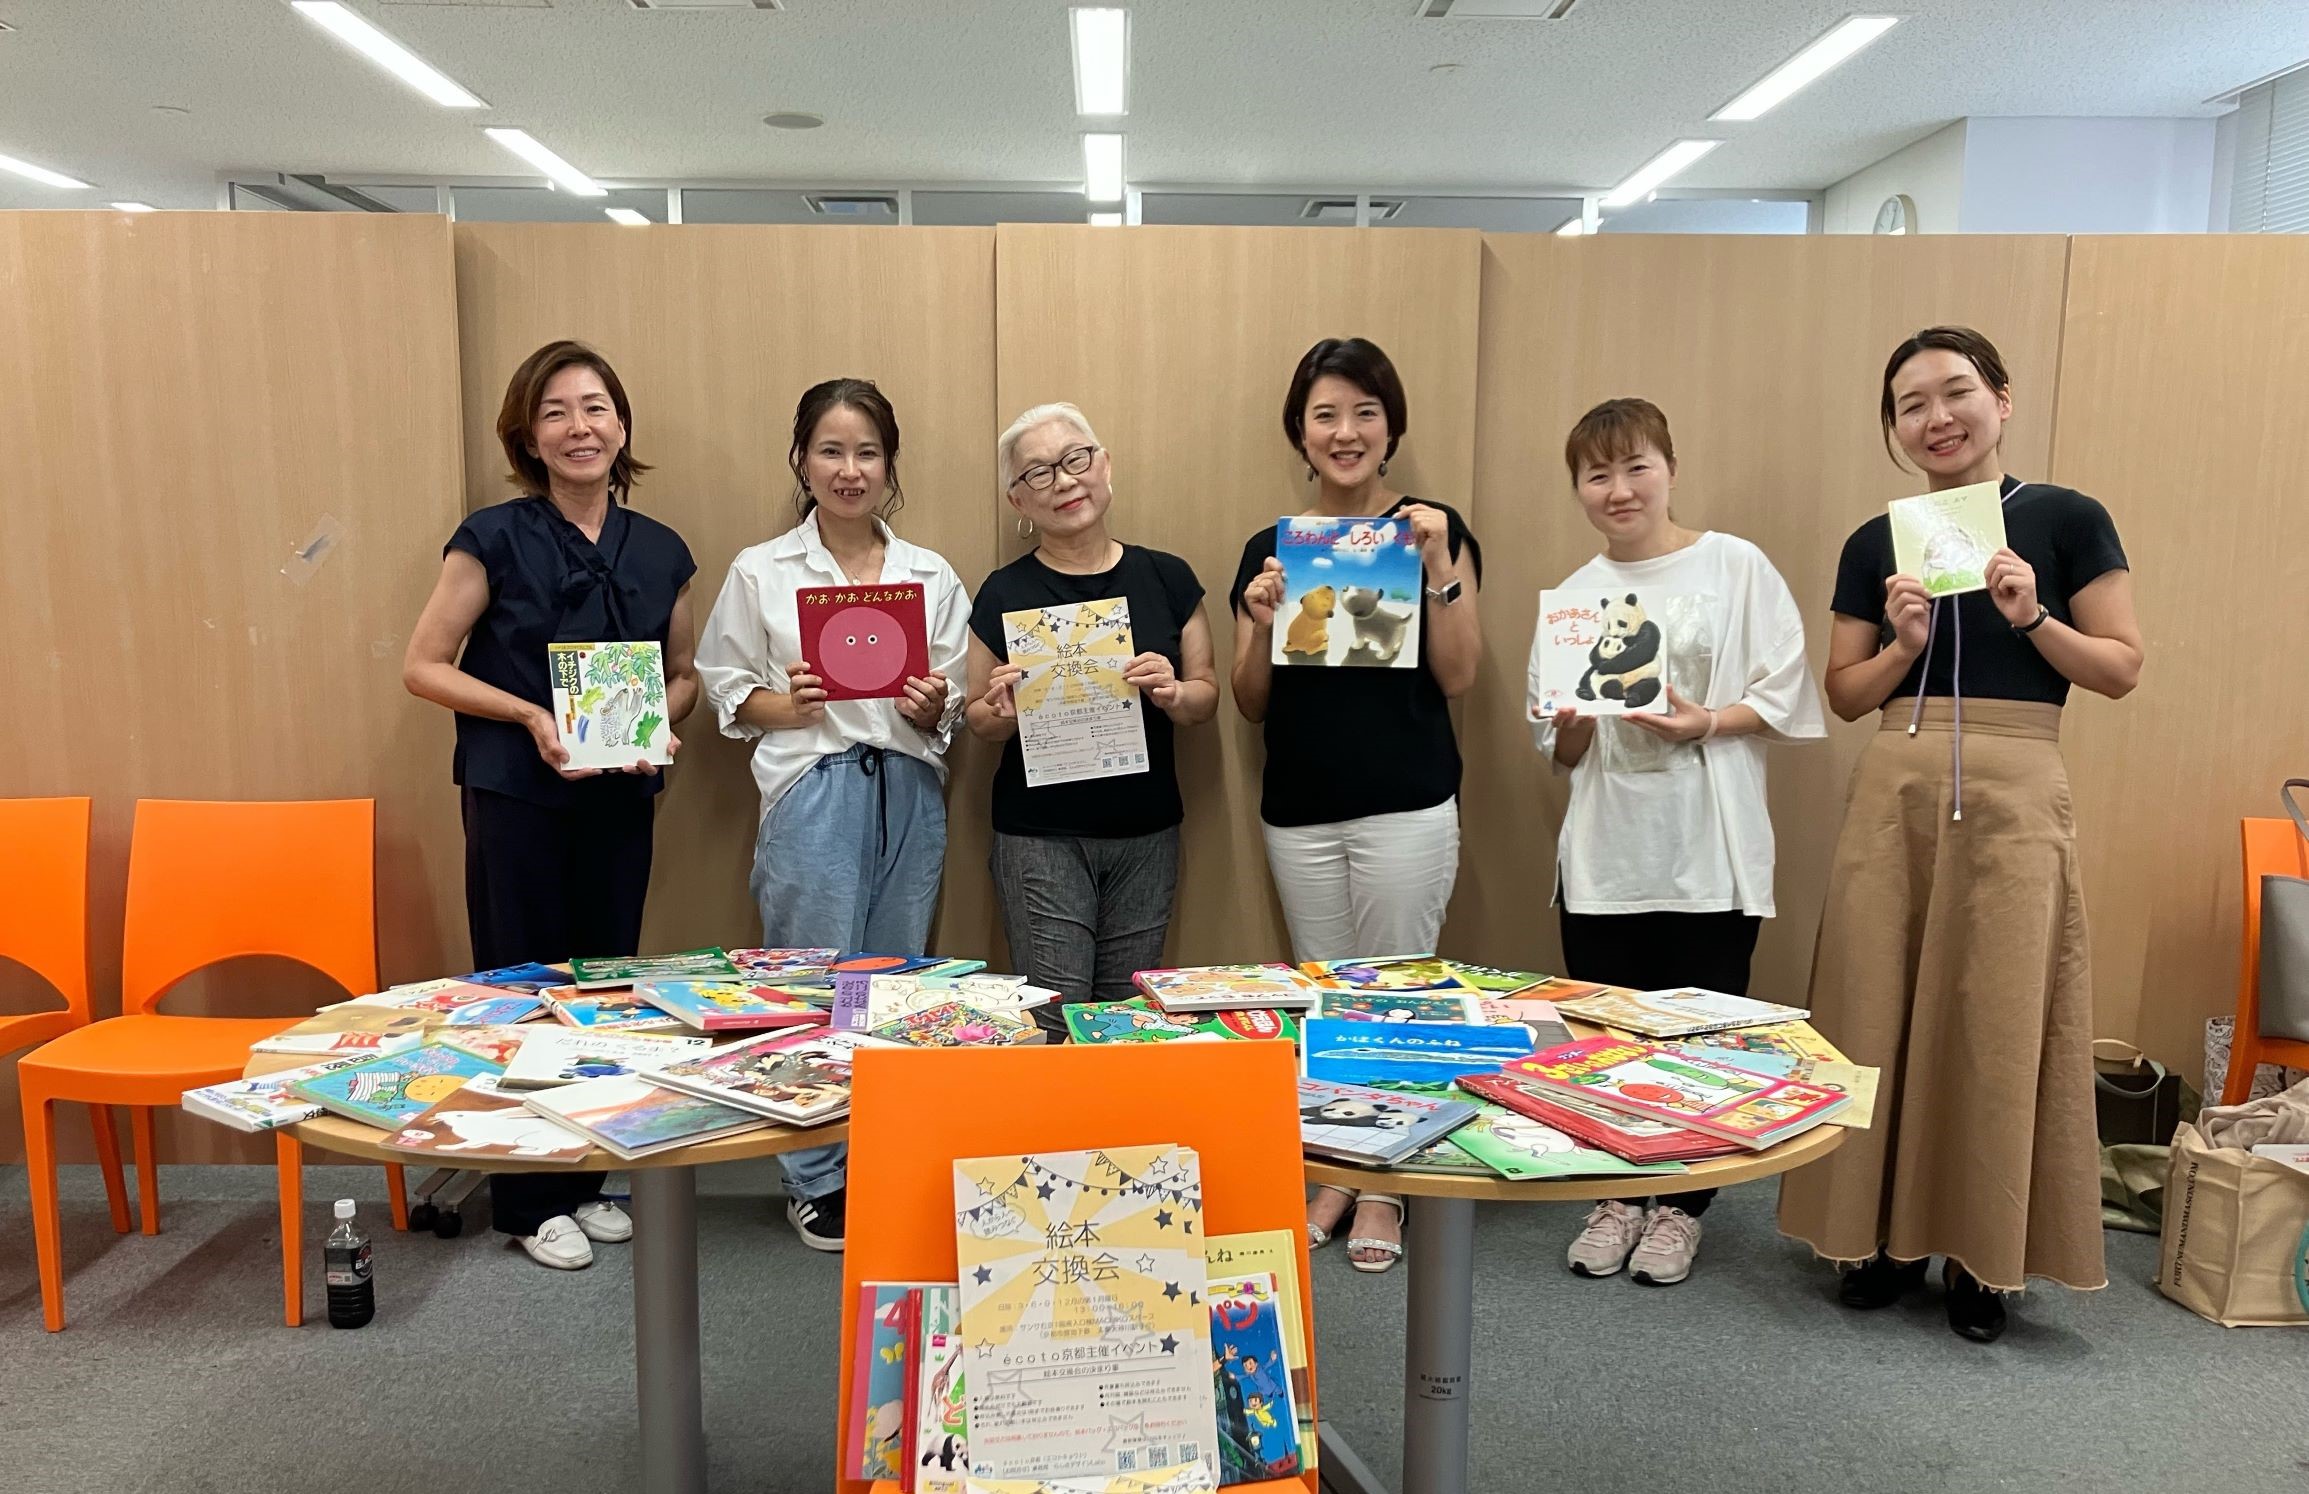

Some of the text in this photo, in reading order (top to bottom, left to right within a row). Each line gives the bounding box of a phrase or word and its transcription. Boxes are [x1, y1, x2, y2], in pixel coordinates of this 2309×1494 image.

[1281, 530, 1340, 545] ころわんと
[1350, 530, 1385, 545] しろい
[806, 589, 917, 605] かお かお どんなかお
[1546, 607, 1600, 624] おかあさん
[1569, 621, 1580, 632] と
[1056, 641, 1087, 659] 絵本
[557, 652, 569, 687] 木の下で
[1050, 659, 1099, 679] 交換会
[1334, 1034, 1461, 1047] かばくんのふね
[2173, 1162, 2199, 1288] FORTNUMANDMASON.COM
[1046, 1219, 1101, 1250] 絵本
[1031, 1252, 1120, 1287] 交換会
[1208, 1300, 1259, 1331] パン
[1431, 1385, 1452, 1395] 20kg
